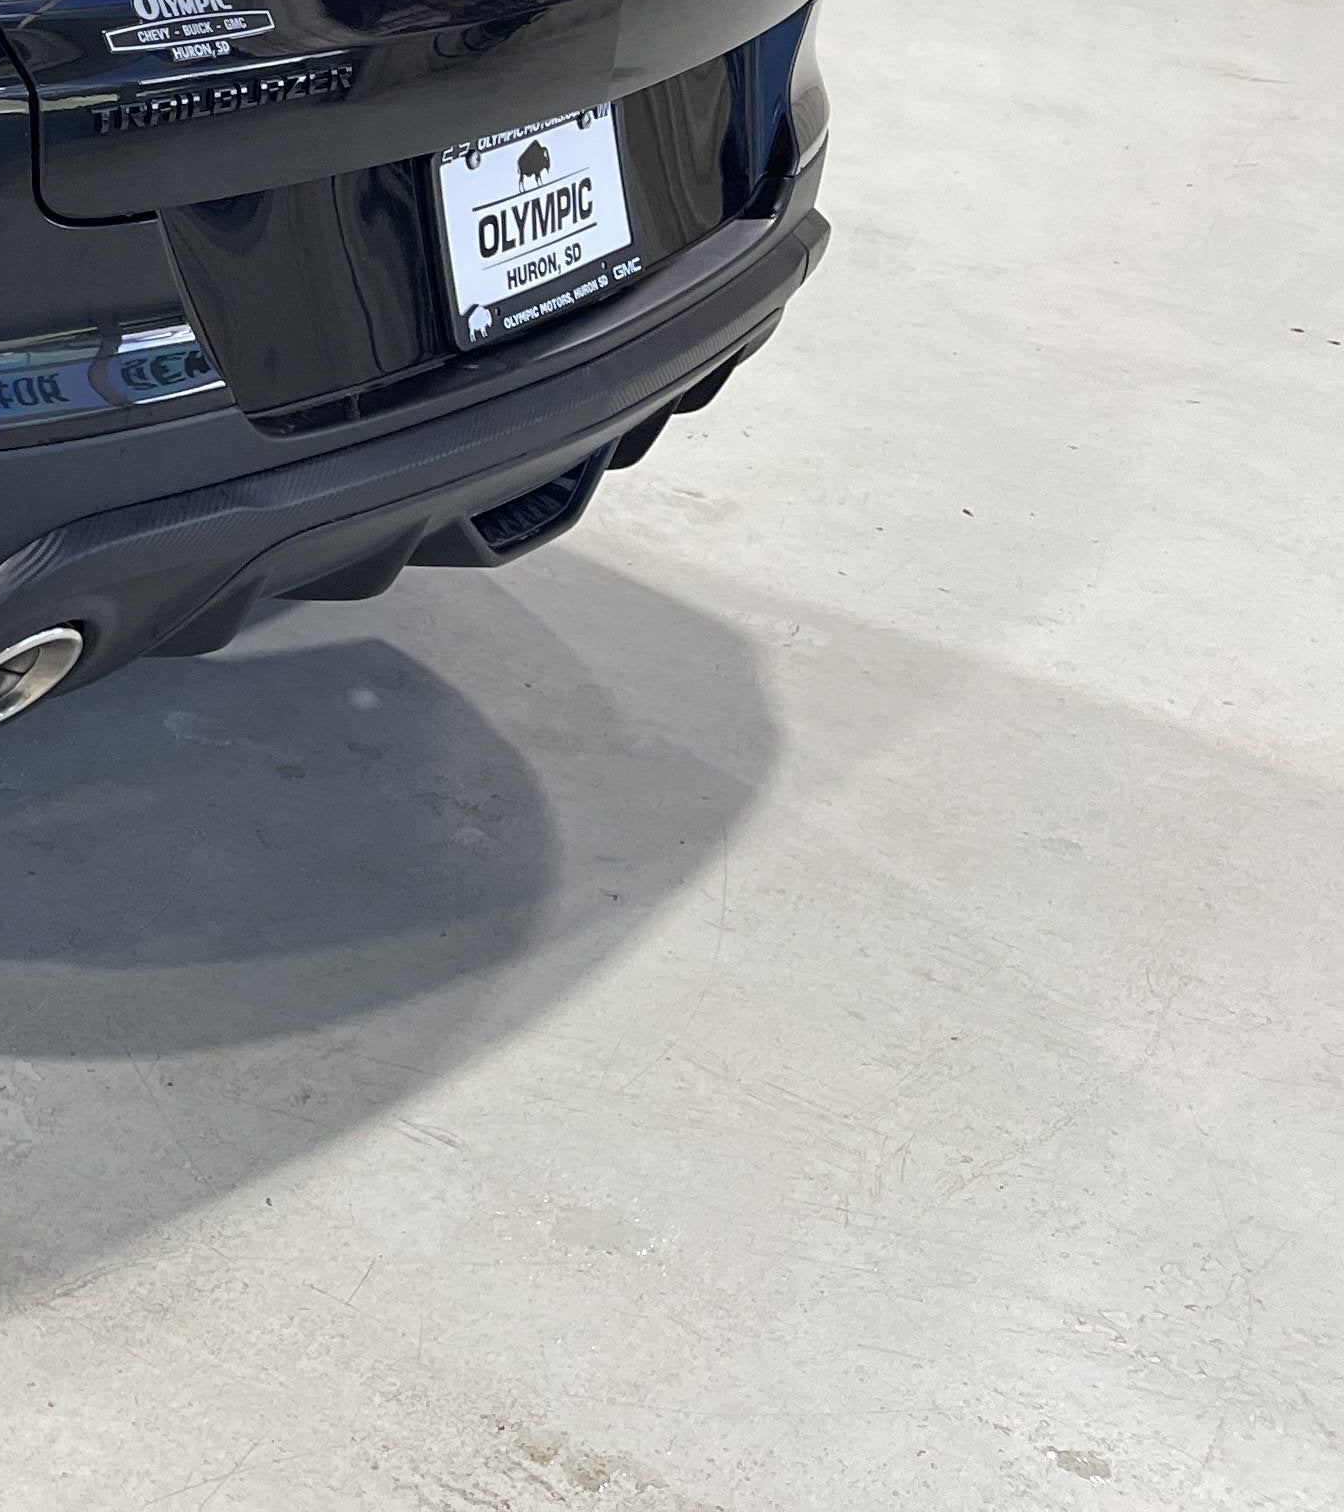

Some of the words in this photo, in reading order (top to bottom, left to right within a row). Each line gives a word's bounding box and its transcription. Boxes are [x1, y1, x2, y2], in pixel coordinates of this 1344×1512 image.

[136, 26, 170, 43] CHEVY
[182, 22, 214, 37] BUICK
[223, 17, 247, 31] GMC
[171, 43, 216, 62] HURON,
[217, 40, 231, 55] SD
[91, 64, 353, 134] TRAILBLAZER
[478, 177, 593, 259] OLYMPIC
[503, 304, 540, 330] OLYMPIC
[540, 292, 575, 316] MOTORS,
[574, 281, 598, 300] HURON
[597, 274, 609, 288] SD
[612, 256, 642, 281] GMC
[506, 251, 562, 290] HURON,
[564, 242, 582, 266] SD
